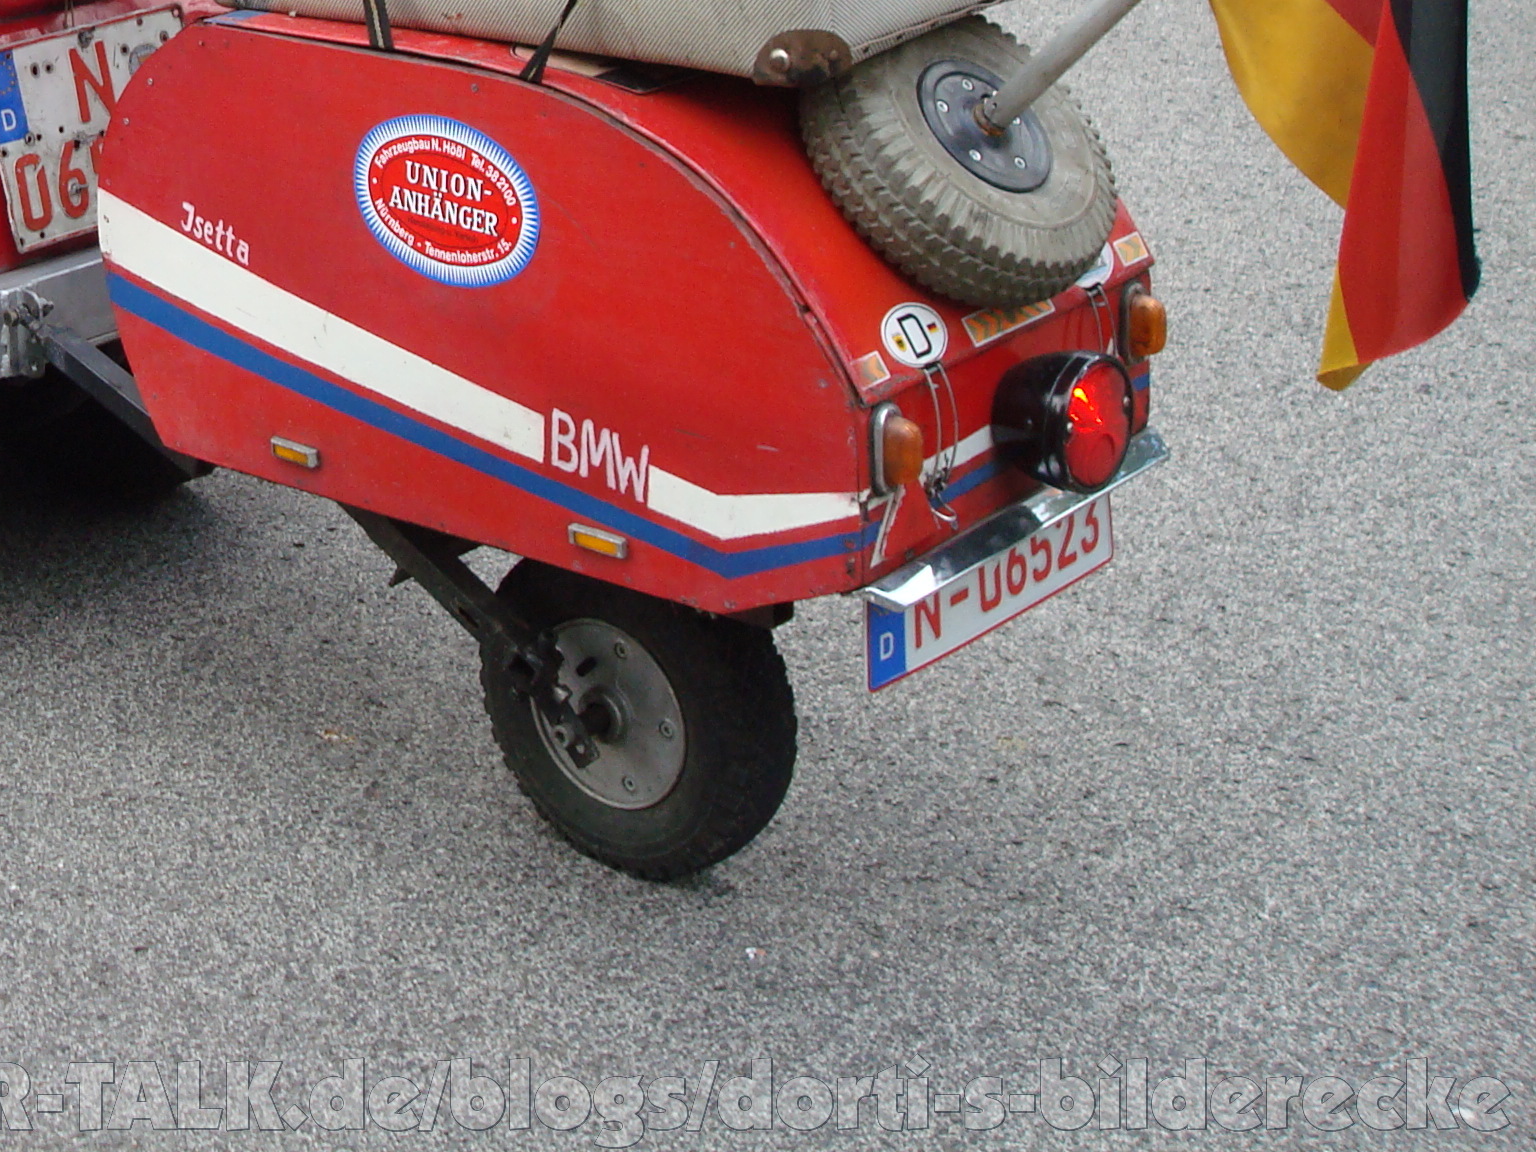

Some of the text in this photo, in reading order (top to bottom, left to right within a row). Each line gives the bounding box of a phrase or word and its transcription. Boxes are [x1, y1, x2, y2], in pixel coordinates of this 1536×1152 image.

[68, 40, 117, 124] N
[1, 107, 17, 132] D
[374, 138, 432, 169] Fahrzeugbau
[405, 160, 493, 202] UNION-
[374, 197, 415, 246] Nürnberg
[389, 185, 499, 237] ANHÄNGER
[897, 313, 933, 359] D
[551, 408, 650, 503] BMW
[879, 631, 895, 662] D
